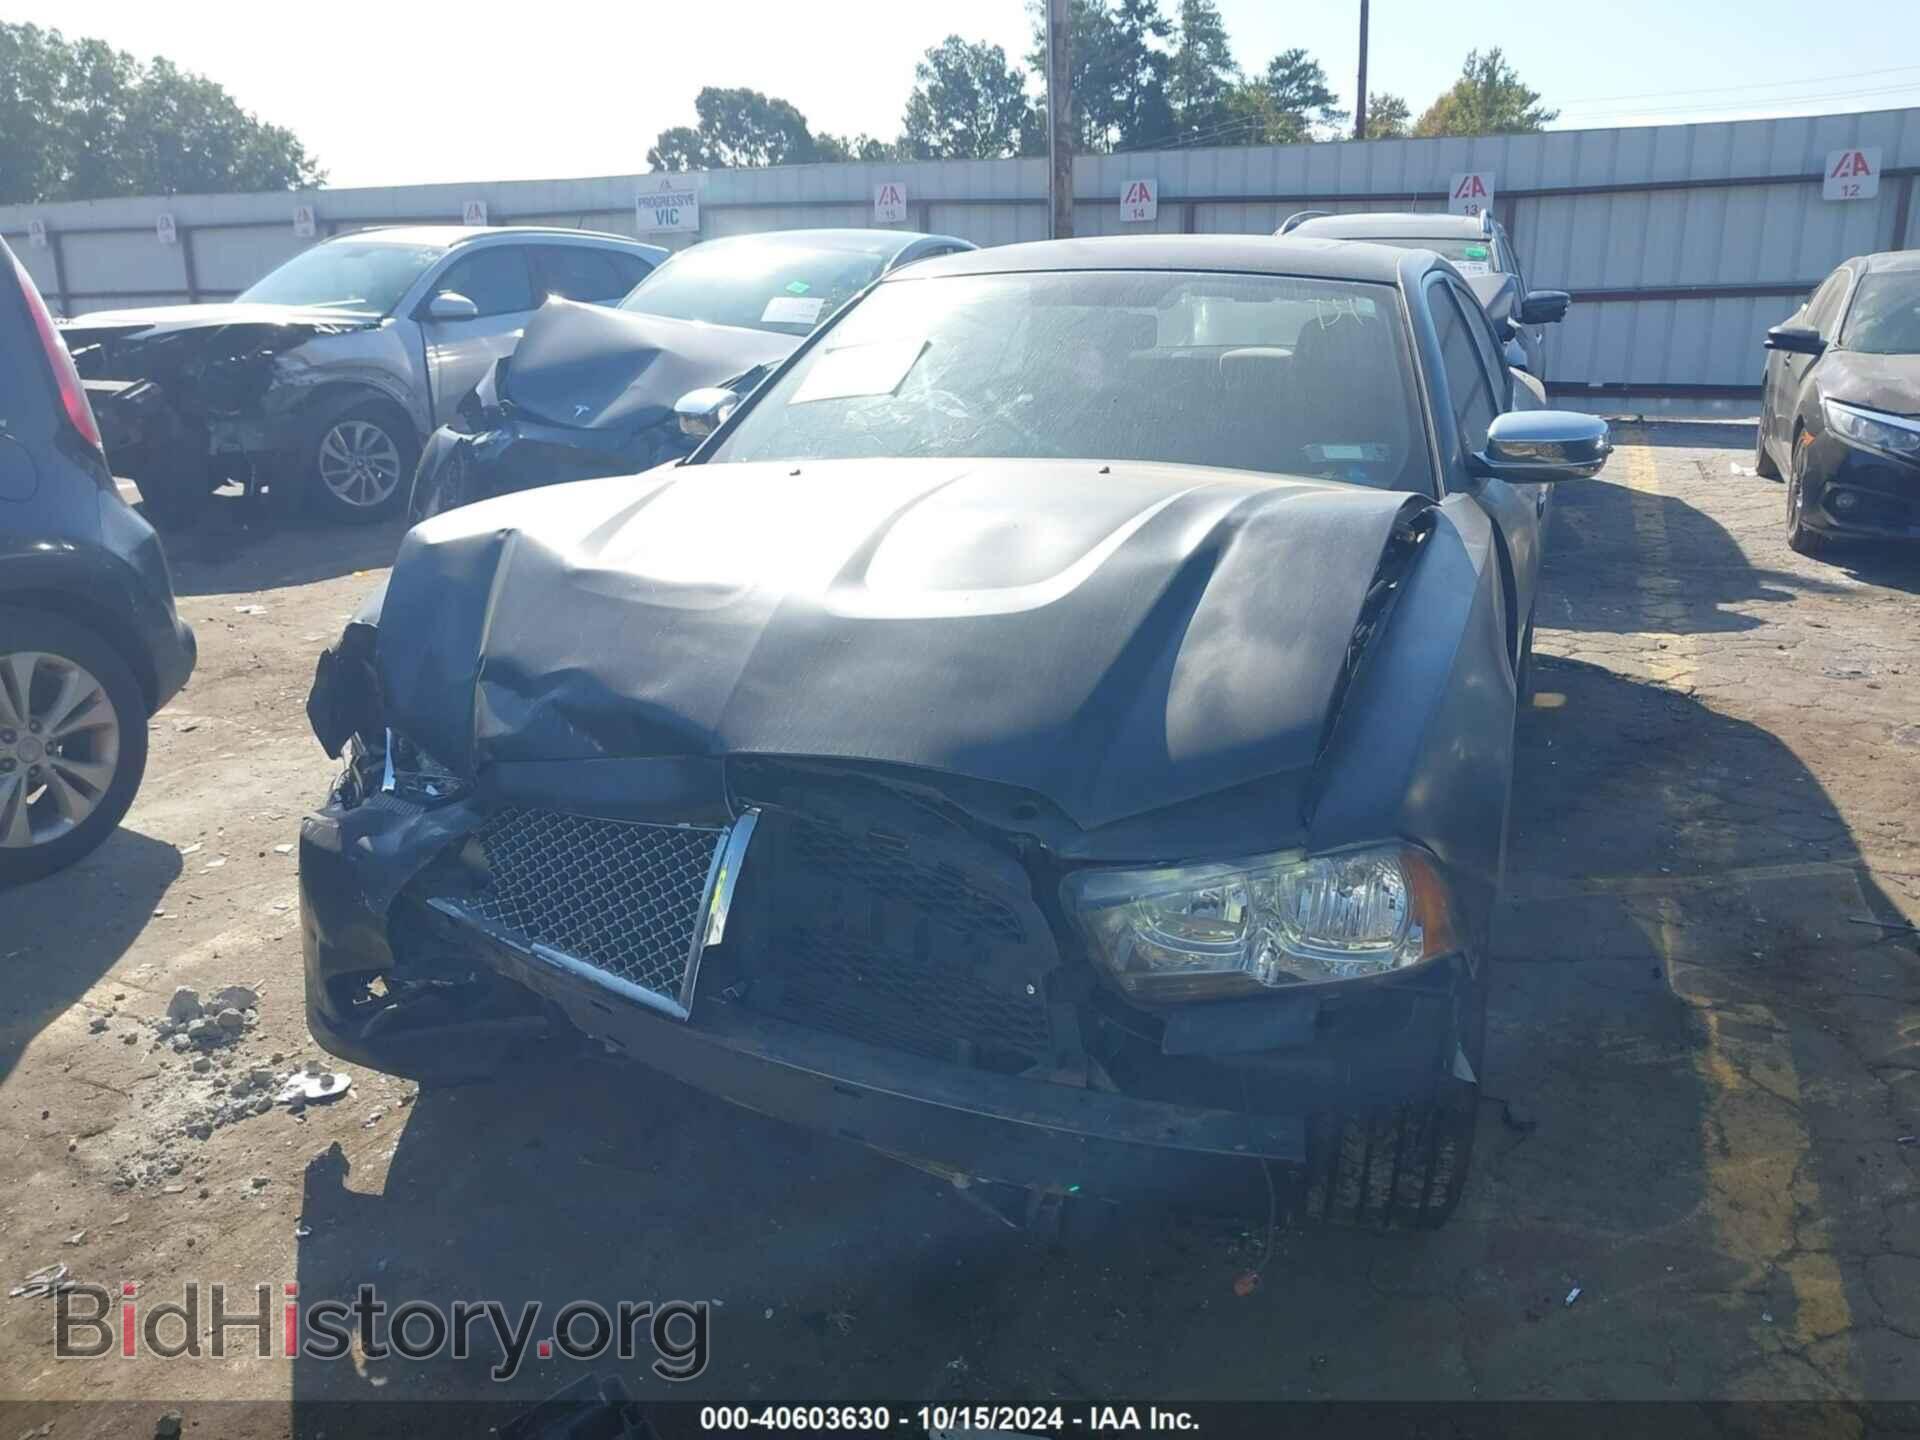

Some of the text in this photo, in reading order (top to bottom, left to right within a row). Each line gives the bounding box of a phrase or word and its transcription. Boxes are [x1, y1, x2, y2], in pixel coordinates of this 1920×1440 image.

[1842, 184, 1860, 197] 12
[638, 193, 695, 208] PROGRESSIVE
[655, 208, 680, 225] VIC
[1464, 203, 1479, 216] 13
